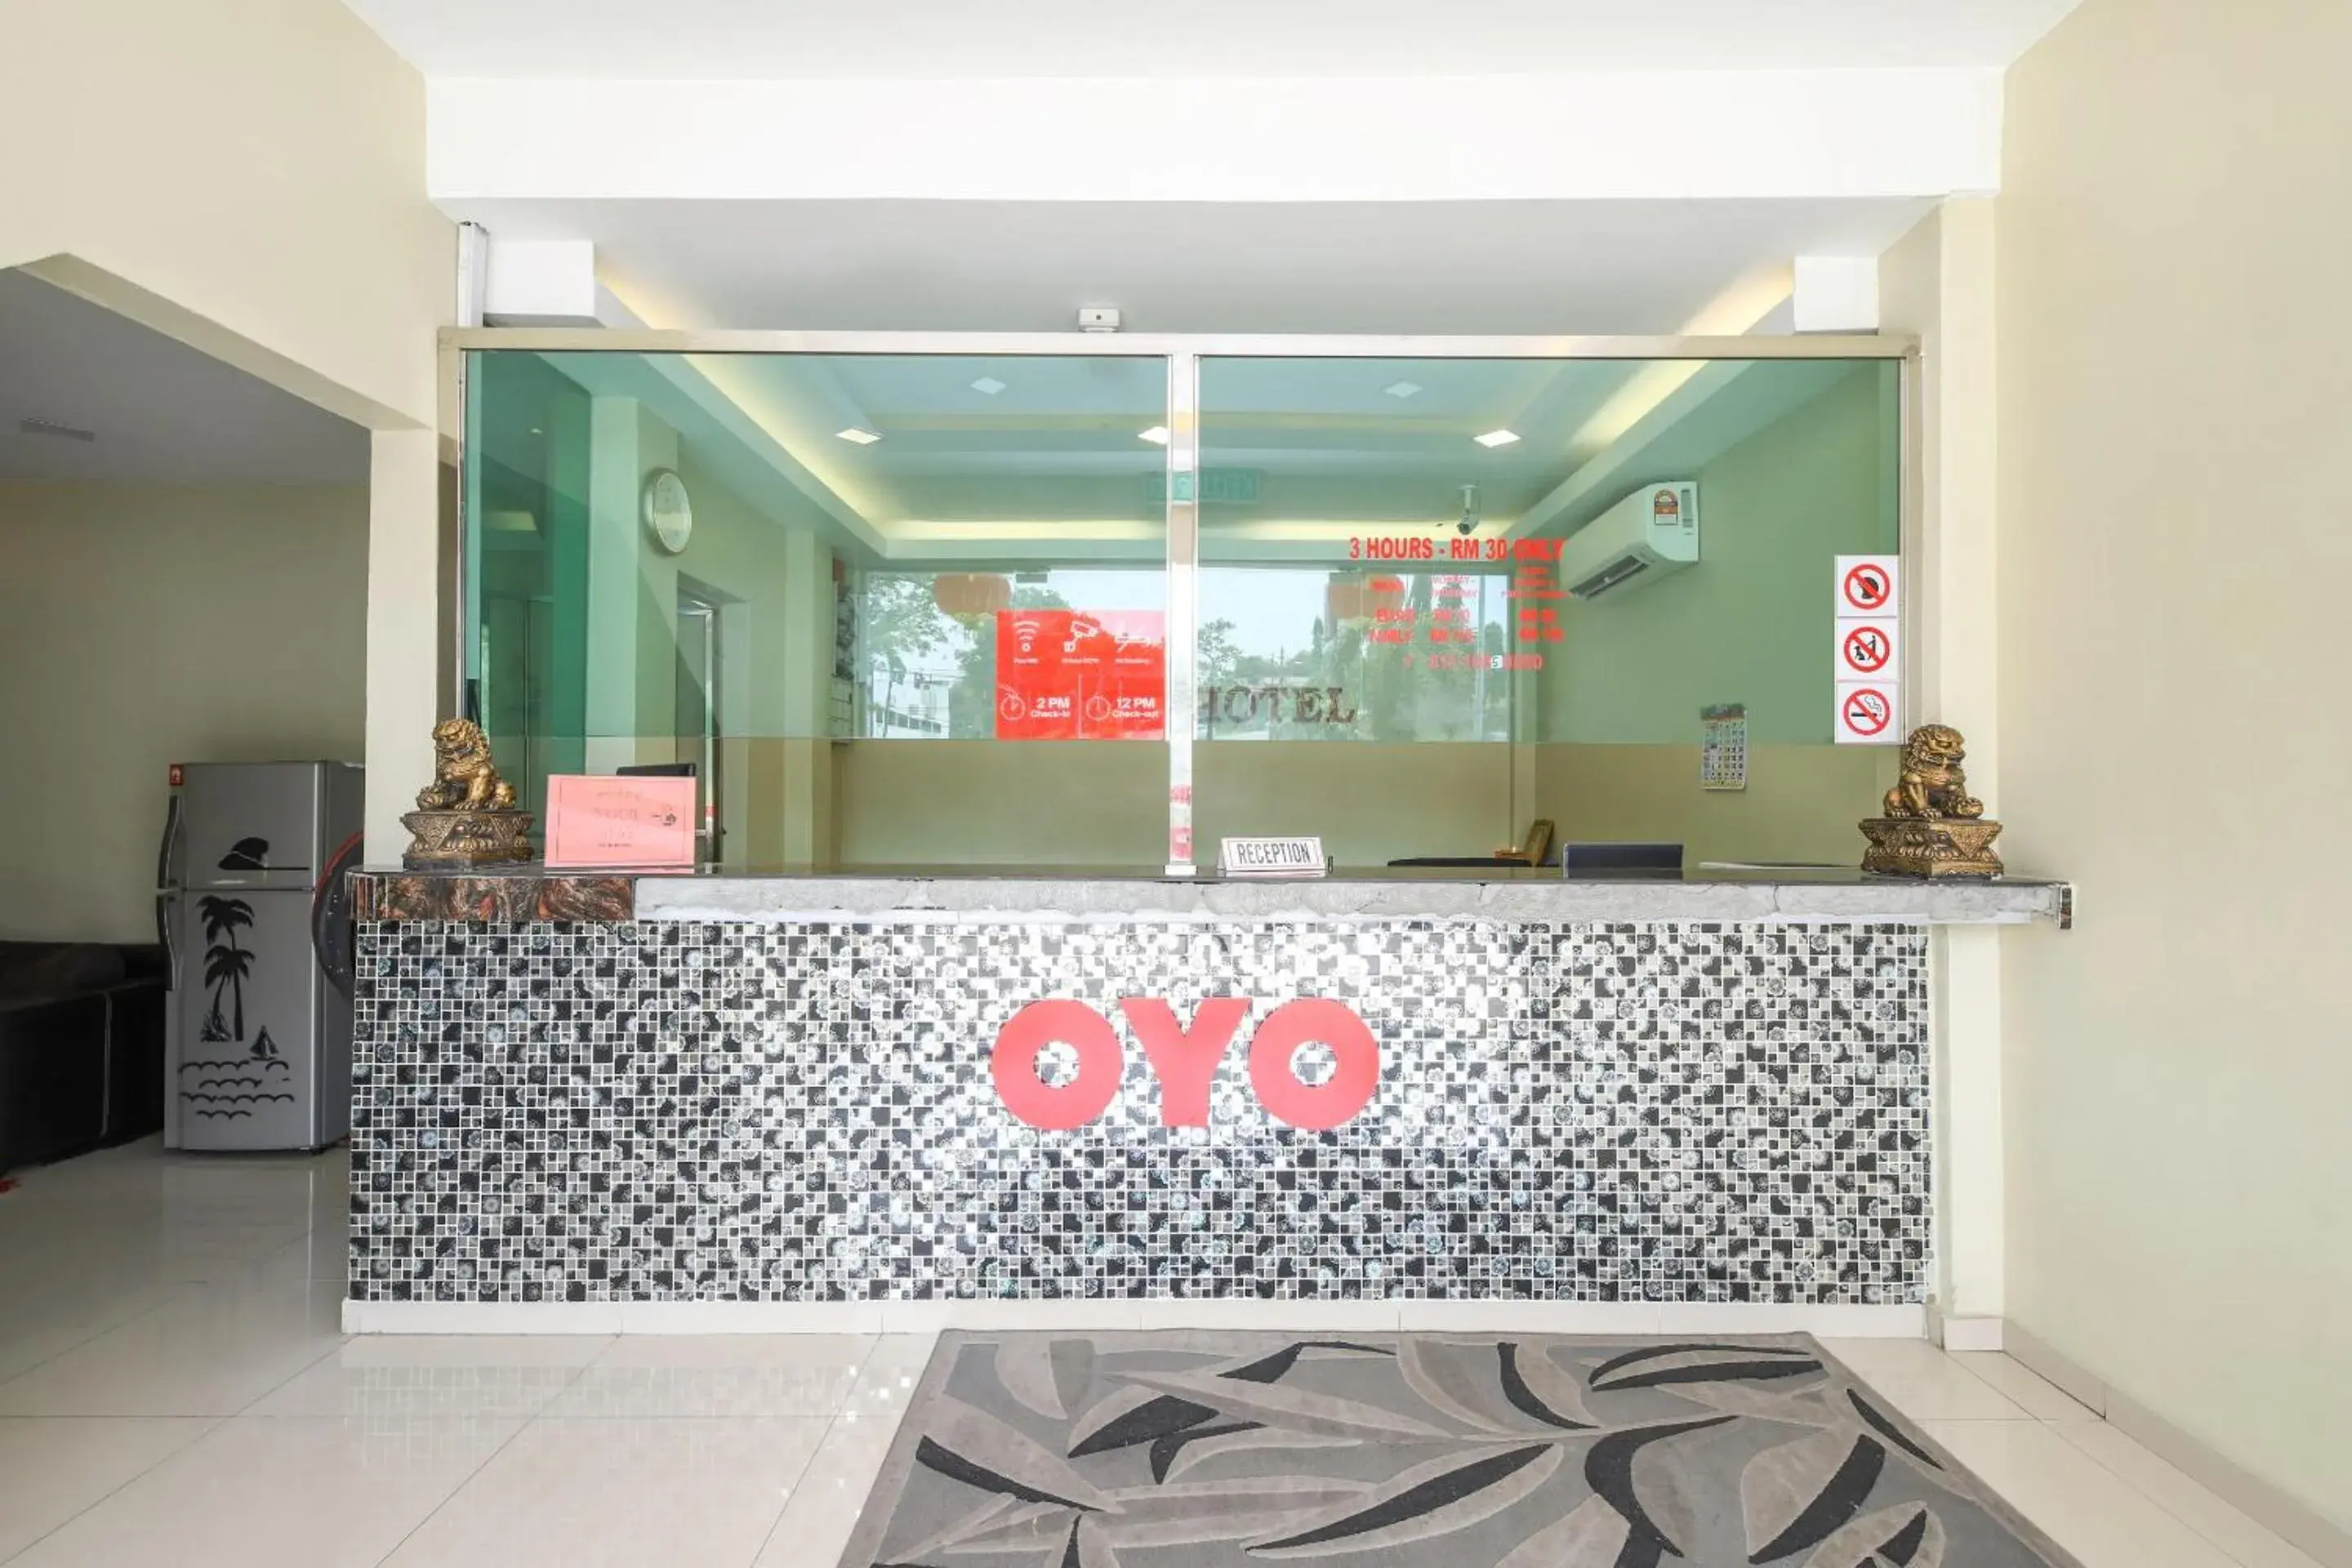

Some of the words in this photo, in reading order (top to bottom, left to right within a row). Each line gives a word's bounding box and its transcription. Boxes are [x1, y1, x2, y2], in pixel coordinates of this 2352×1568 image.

[1349, 538, 1360, 559] 3
[1366, 537, 1432, 559] HOURS
[1451, 538, 1479, 559] RM
[1486, 539, 1507, 559] 30
[1036, 697, 1045, 708] 2
[1049, 697, 1070, 709] PM
[1116, 697, 1130, 709] 12
[1134, 697, 1156, 709] PM
[1111, 710, 1159, 719] Check-out
[1237, 843, 1311, 864] RECEPTION
[991, 997, 1380, 1130] OYO
